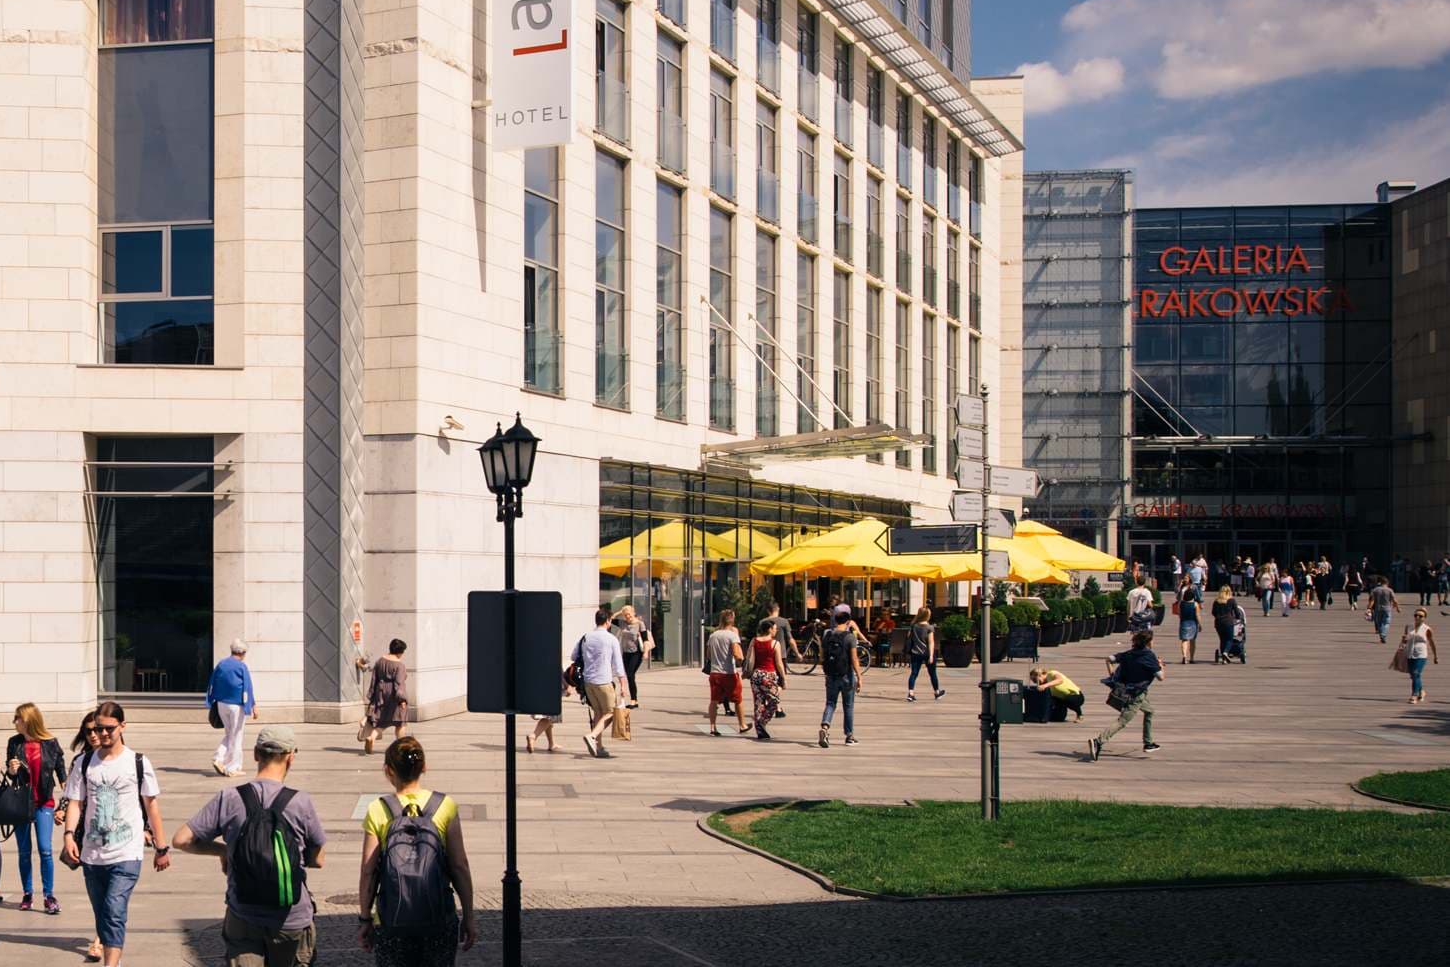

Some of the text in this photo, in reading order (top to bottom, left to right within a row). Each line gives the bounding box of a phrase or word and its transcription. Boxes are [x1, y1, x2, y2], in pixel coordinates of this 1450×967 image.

[495, 105, 568, 127] HOTEL
[1159, 244, 1311, 277] GALERIA
[1133, 502, 1207, 519] GALERIA
